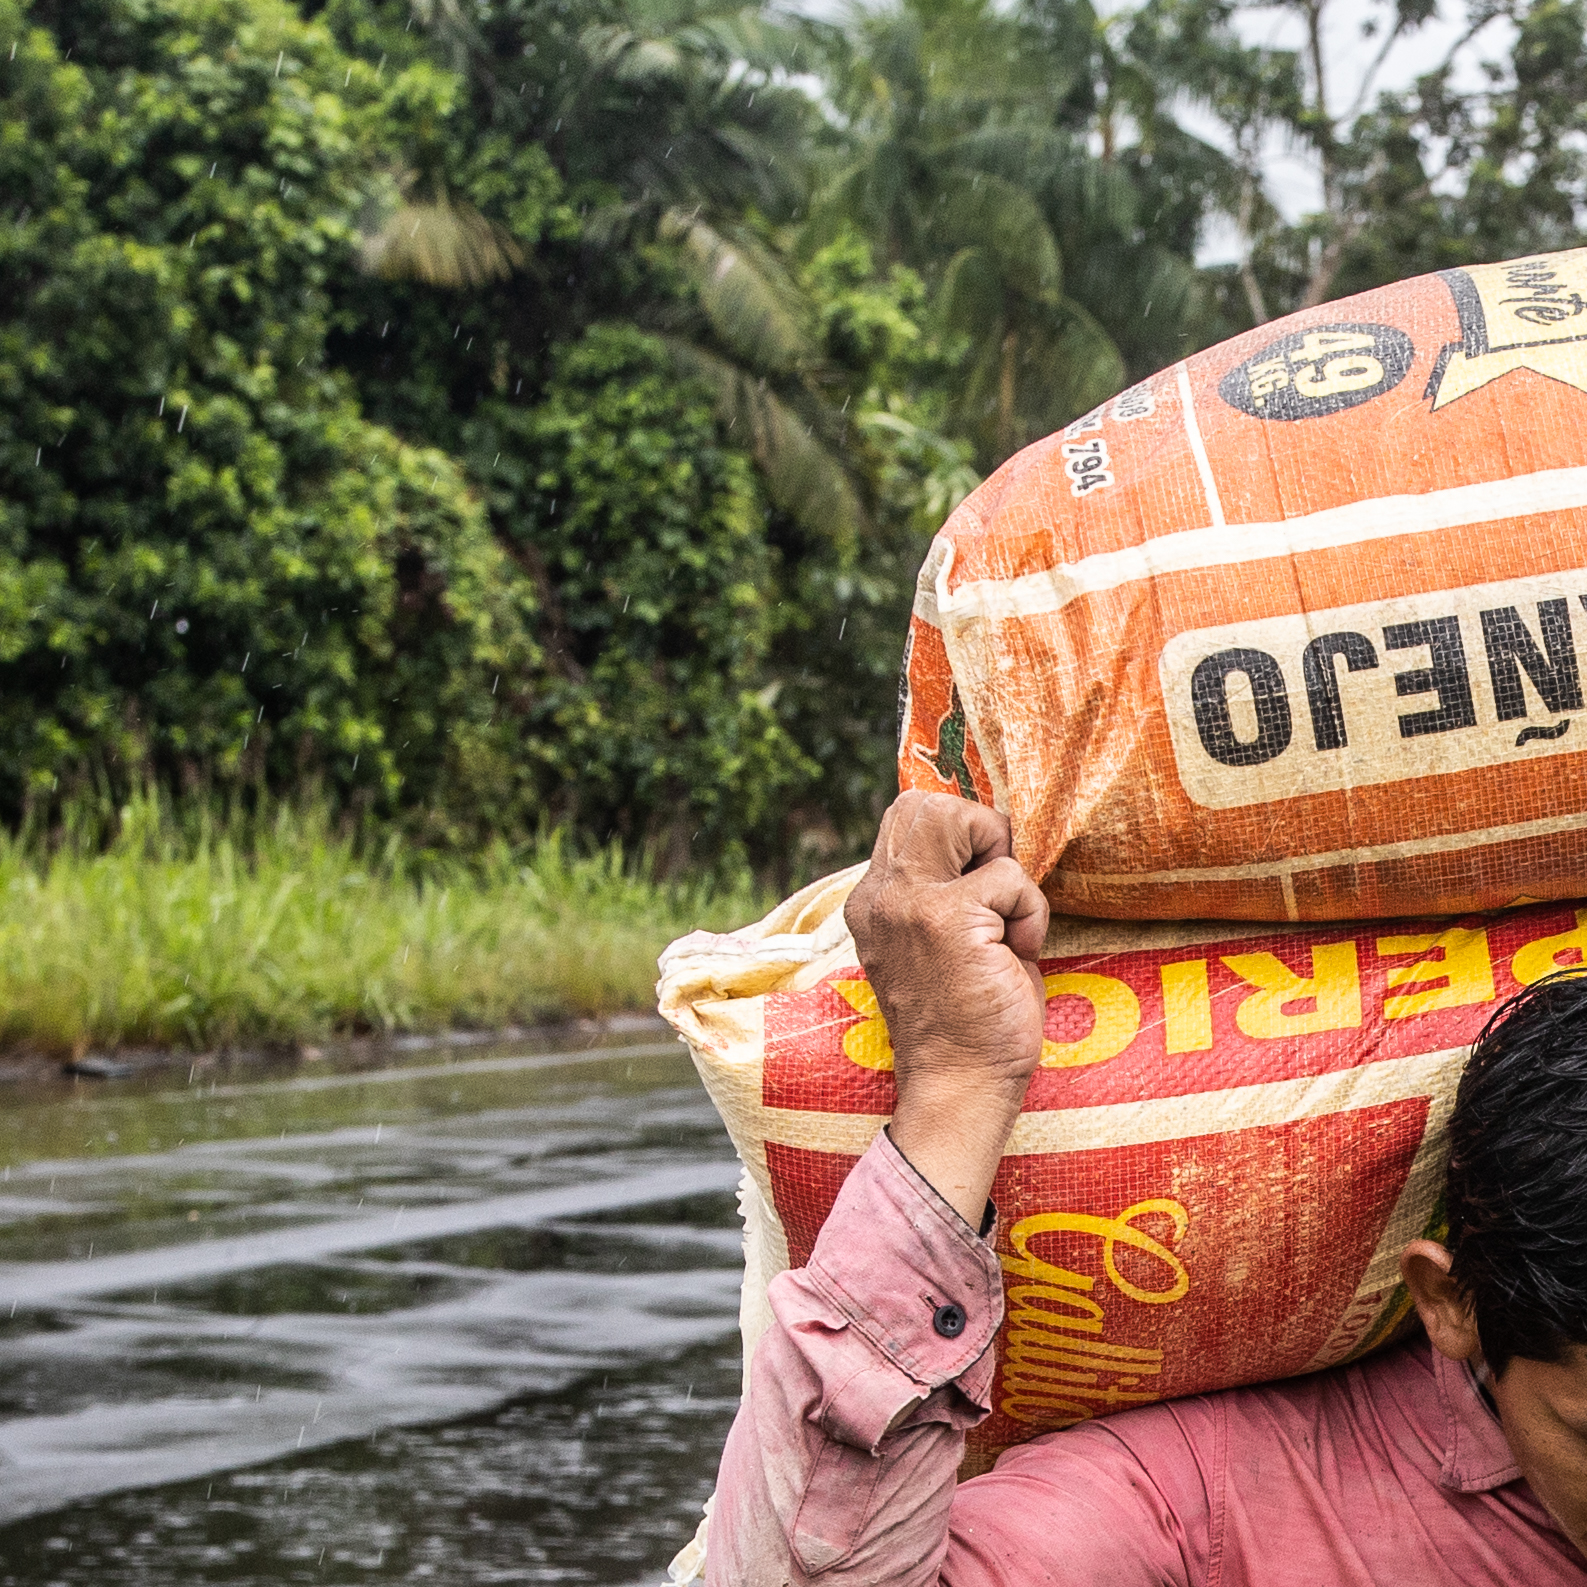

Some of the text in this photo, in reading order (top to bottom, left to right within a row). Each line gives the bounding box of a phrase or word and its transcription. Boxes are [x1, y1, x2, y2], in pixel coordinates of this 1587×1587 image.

[1290, 331, 1385, 399] 49
[1068, 441, 1108, 491] 794
[1000, 1198, 1190, 1424] Gallito
